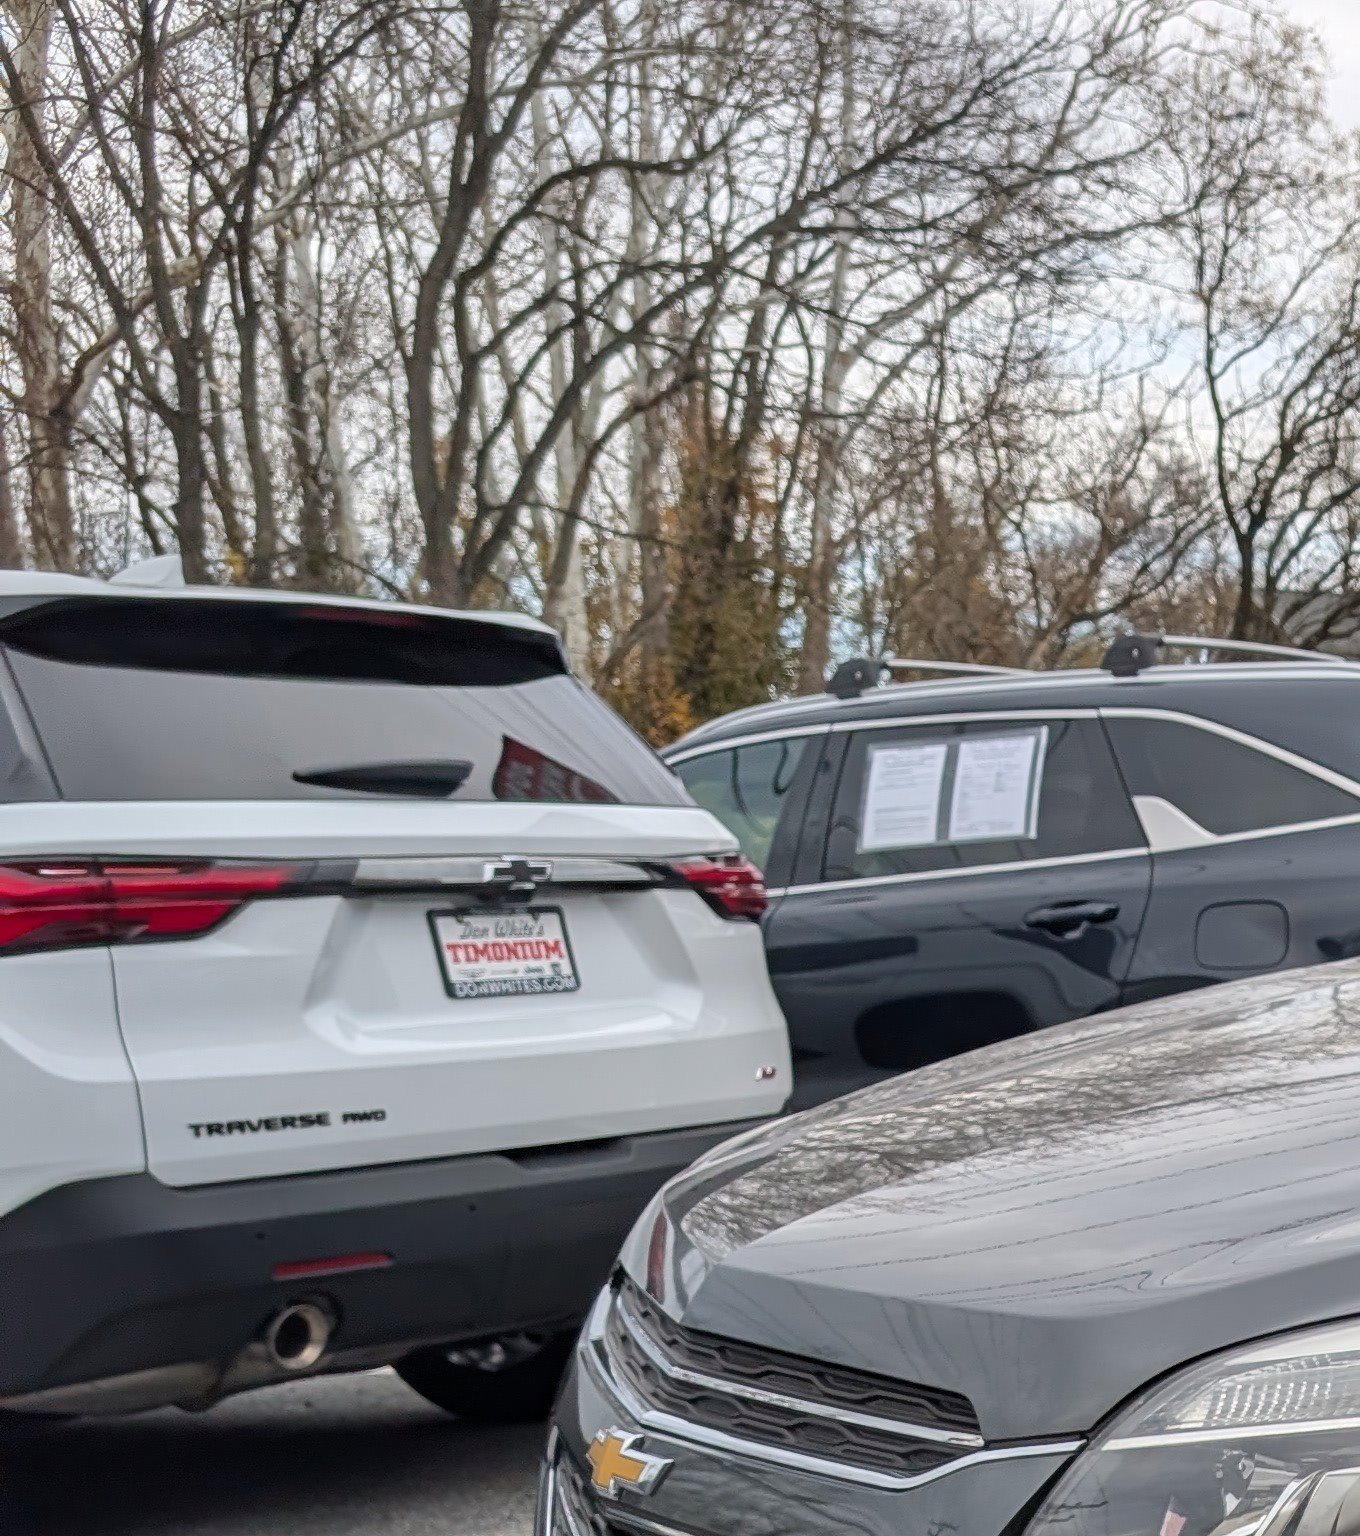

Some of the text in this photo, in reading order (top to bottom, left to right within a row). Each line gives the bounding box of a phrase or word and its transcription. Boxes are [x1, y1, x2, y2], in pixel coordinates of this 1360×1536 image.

[446, 940, 564, 963] TIMONIUM
[188, 1108, 386, 1139] TRAVERSE AWD
